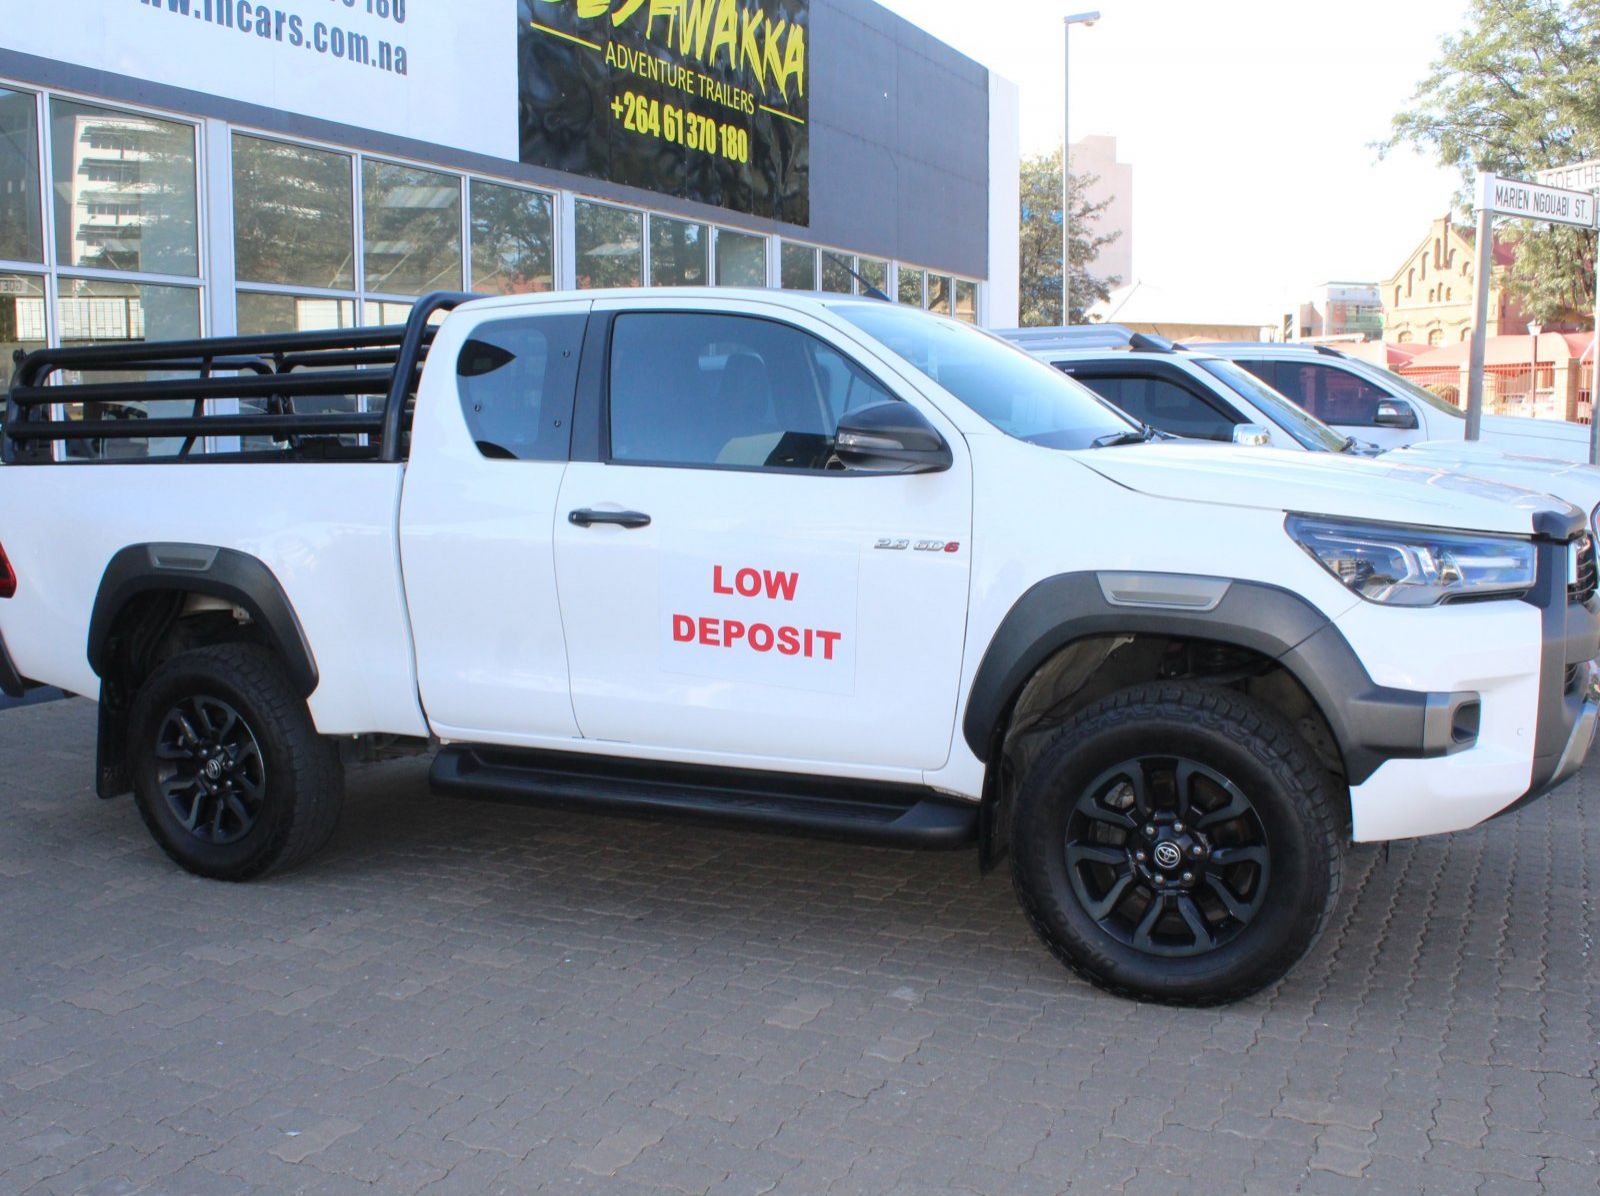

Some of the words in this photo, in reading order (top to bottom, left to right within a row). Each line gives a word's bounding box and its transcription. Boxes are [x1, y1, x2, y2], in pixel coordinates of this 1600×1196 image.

[605, 41, 694, 94] ADVENTURE
[698, 74, 755, 115] TRAILERS
[611, 91, 661, 137] +264
[664, 104, 684, 144] 61
[686, 112, 717, 154] 370
[719, 124, 748, 163] 180
[1495, 185, 1530, 210] MARIEN
[1533, 191, 1570, 217] NGOUABI
[713, 565, 799, 601] LOW
[672, 614, 841, 660] DEPOSIT
